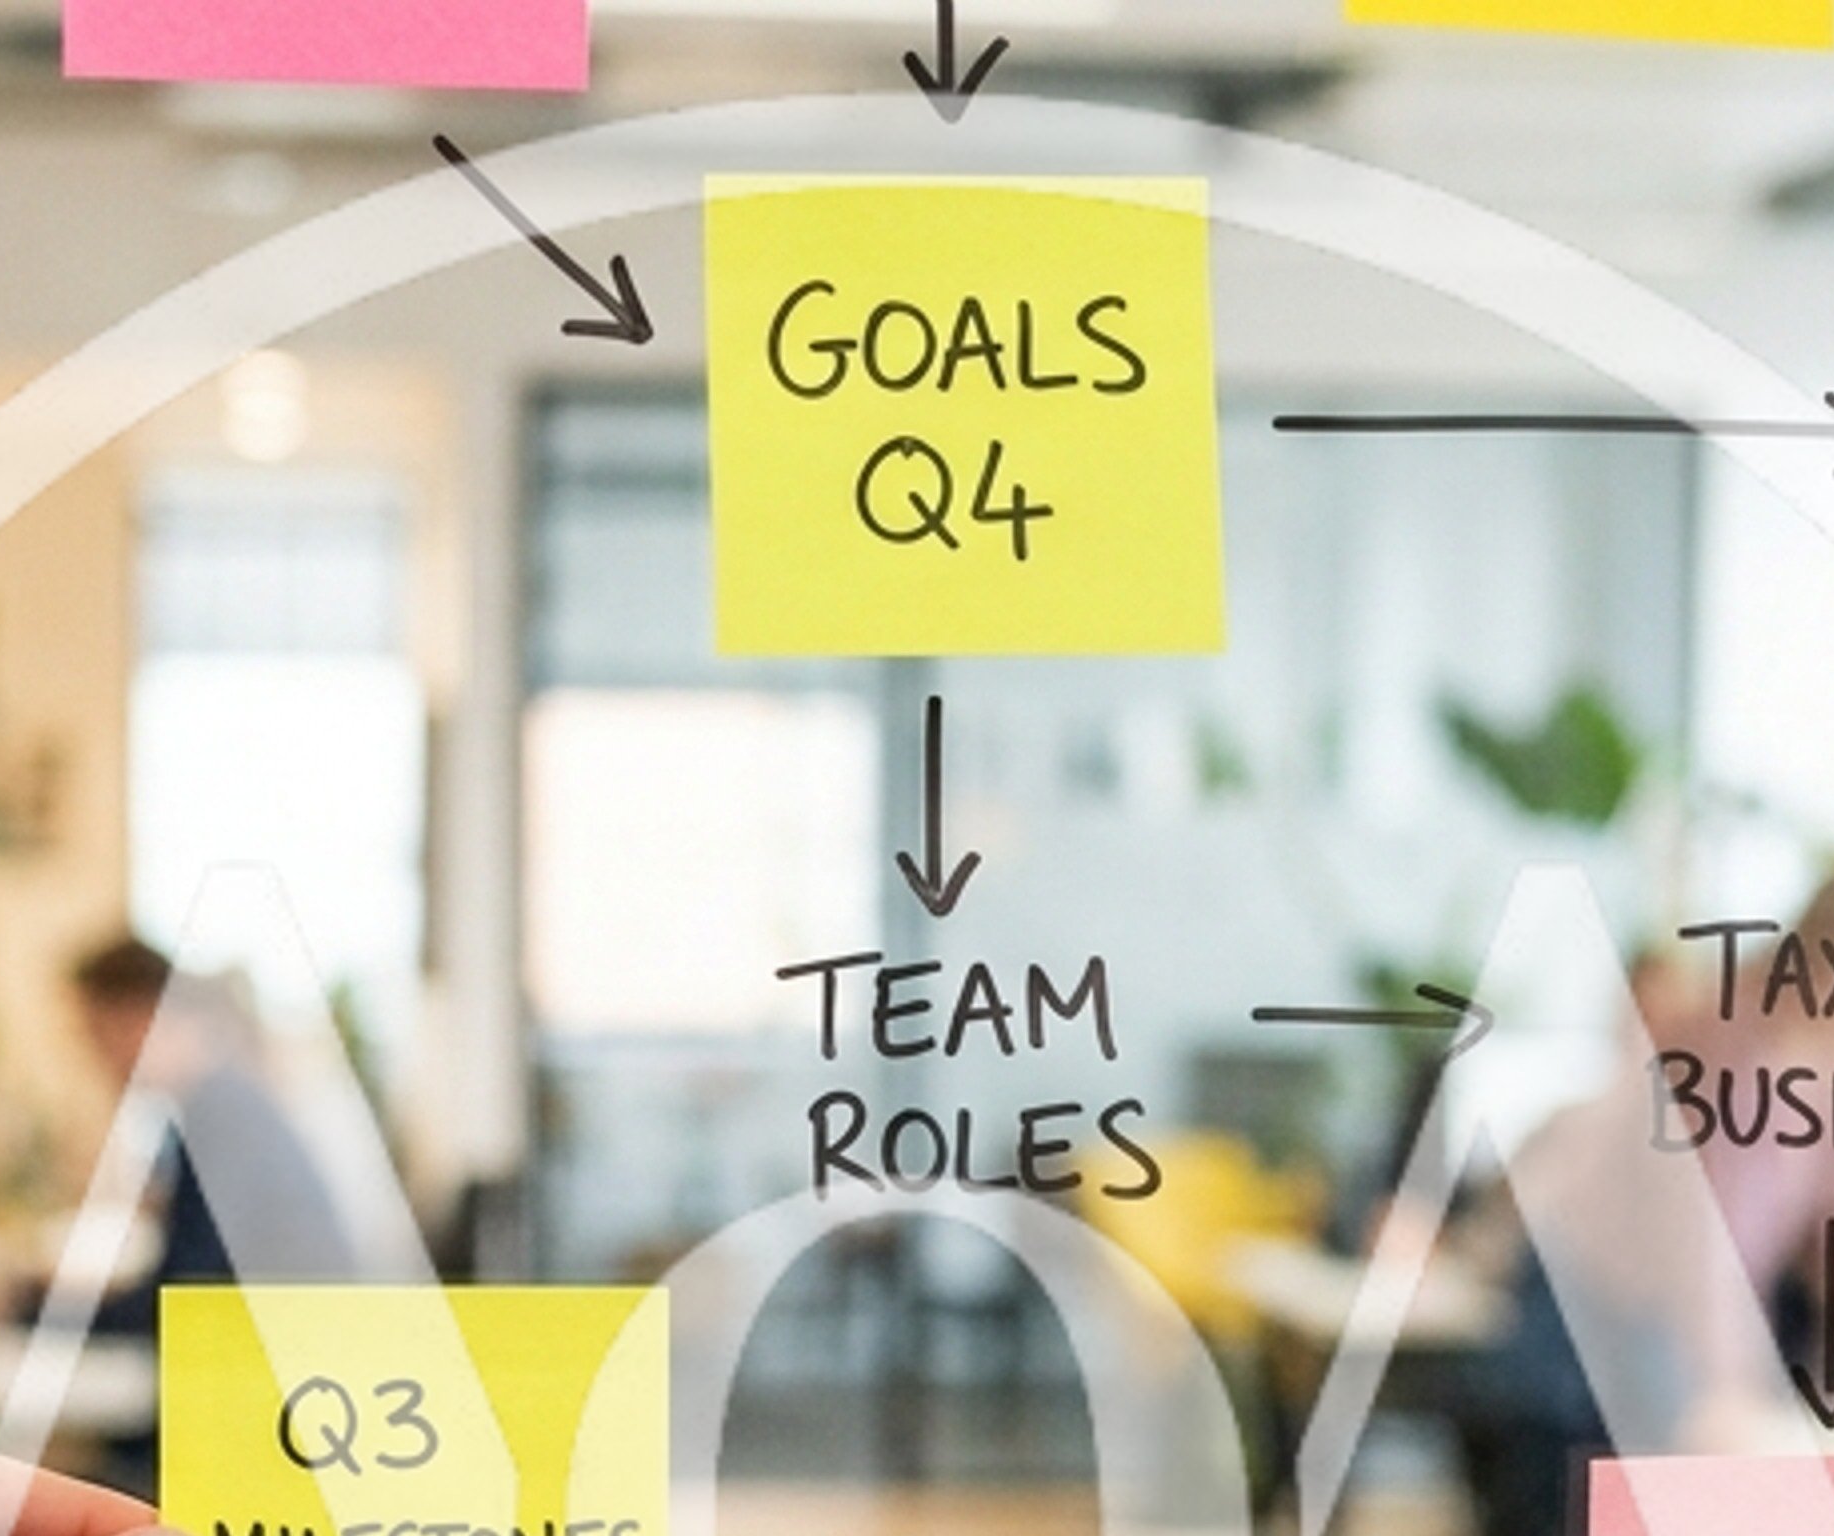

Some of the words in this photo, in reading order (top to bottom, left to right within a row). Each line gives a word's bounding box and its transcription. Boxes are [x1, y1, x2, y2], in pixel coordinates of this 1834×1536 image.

[767, 279, 1147, 399] GOALS
[855, 435, 1055, 562] Q4
[776, 951, 1119, 1062] TEAM
[810, 1089, 1163, 1200] ROLES
[276, 1376, 439, 1475] Q3
